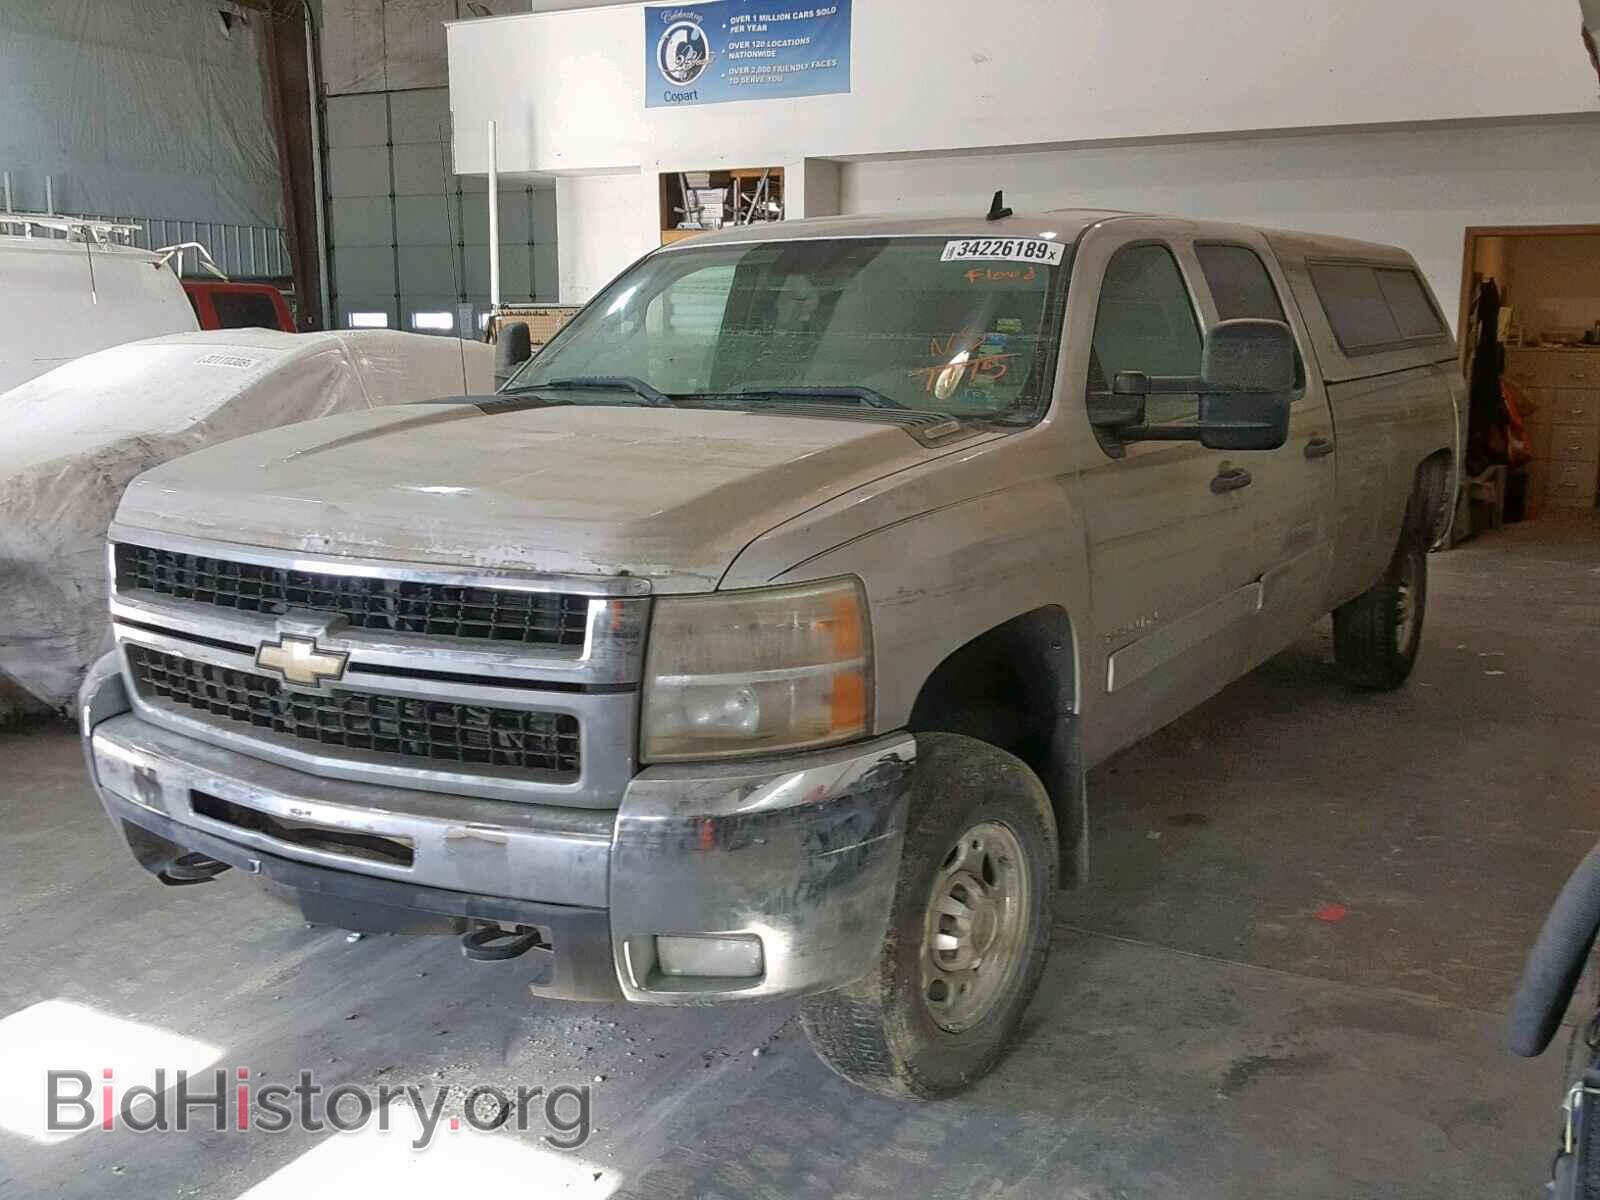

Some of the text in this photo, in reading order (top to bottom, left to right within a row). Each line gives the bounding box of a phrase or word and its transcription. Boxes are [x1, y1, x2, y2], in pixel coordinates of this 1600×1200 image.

[730, 15, 751, 24] OVER
[759, 12, 791, 21] MILLION
[793, 10, 814, 19] CARS
[816, 7, 837, 16] SOLD
[730, 24, 768, 33] PER YEAR
[728, 37, 811, 50] OVER 120 LOCATIONS
[728, 50, 777, 60] NATIONWIDE
[728, 67, 749, 75] OVER
[773, 62, 808, 72] FRIENDLY
[811, 60, 837, 68] FACES
[729, 74, 783, 84] TO SERVE YOU
[663, 90, 699, 104] Copart
[957, 240, 1049, 259] 34226189
